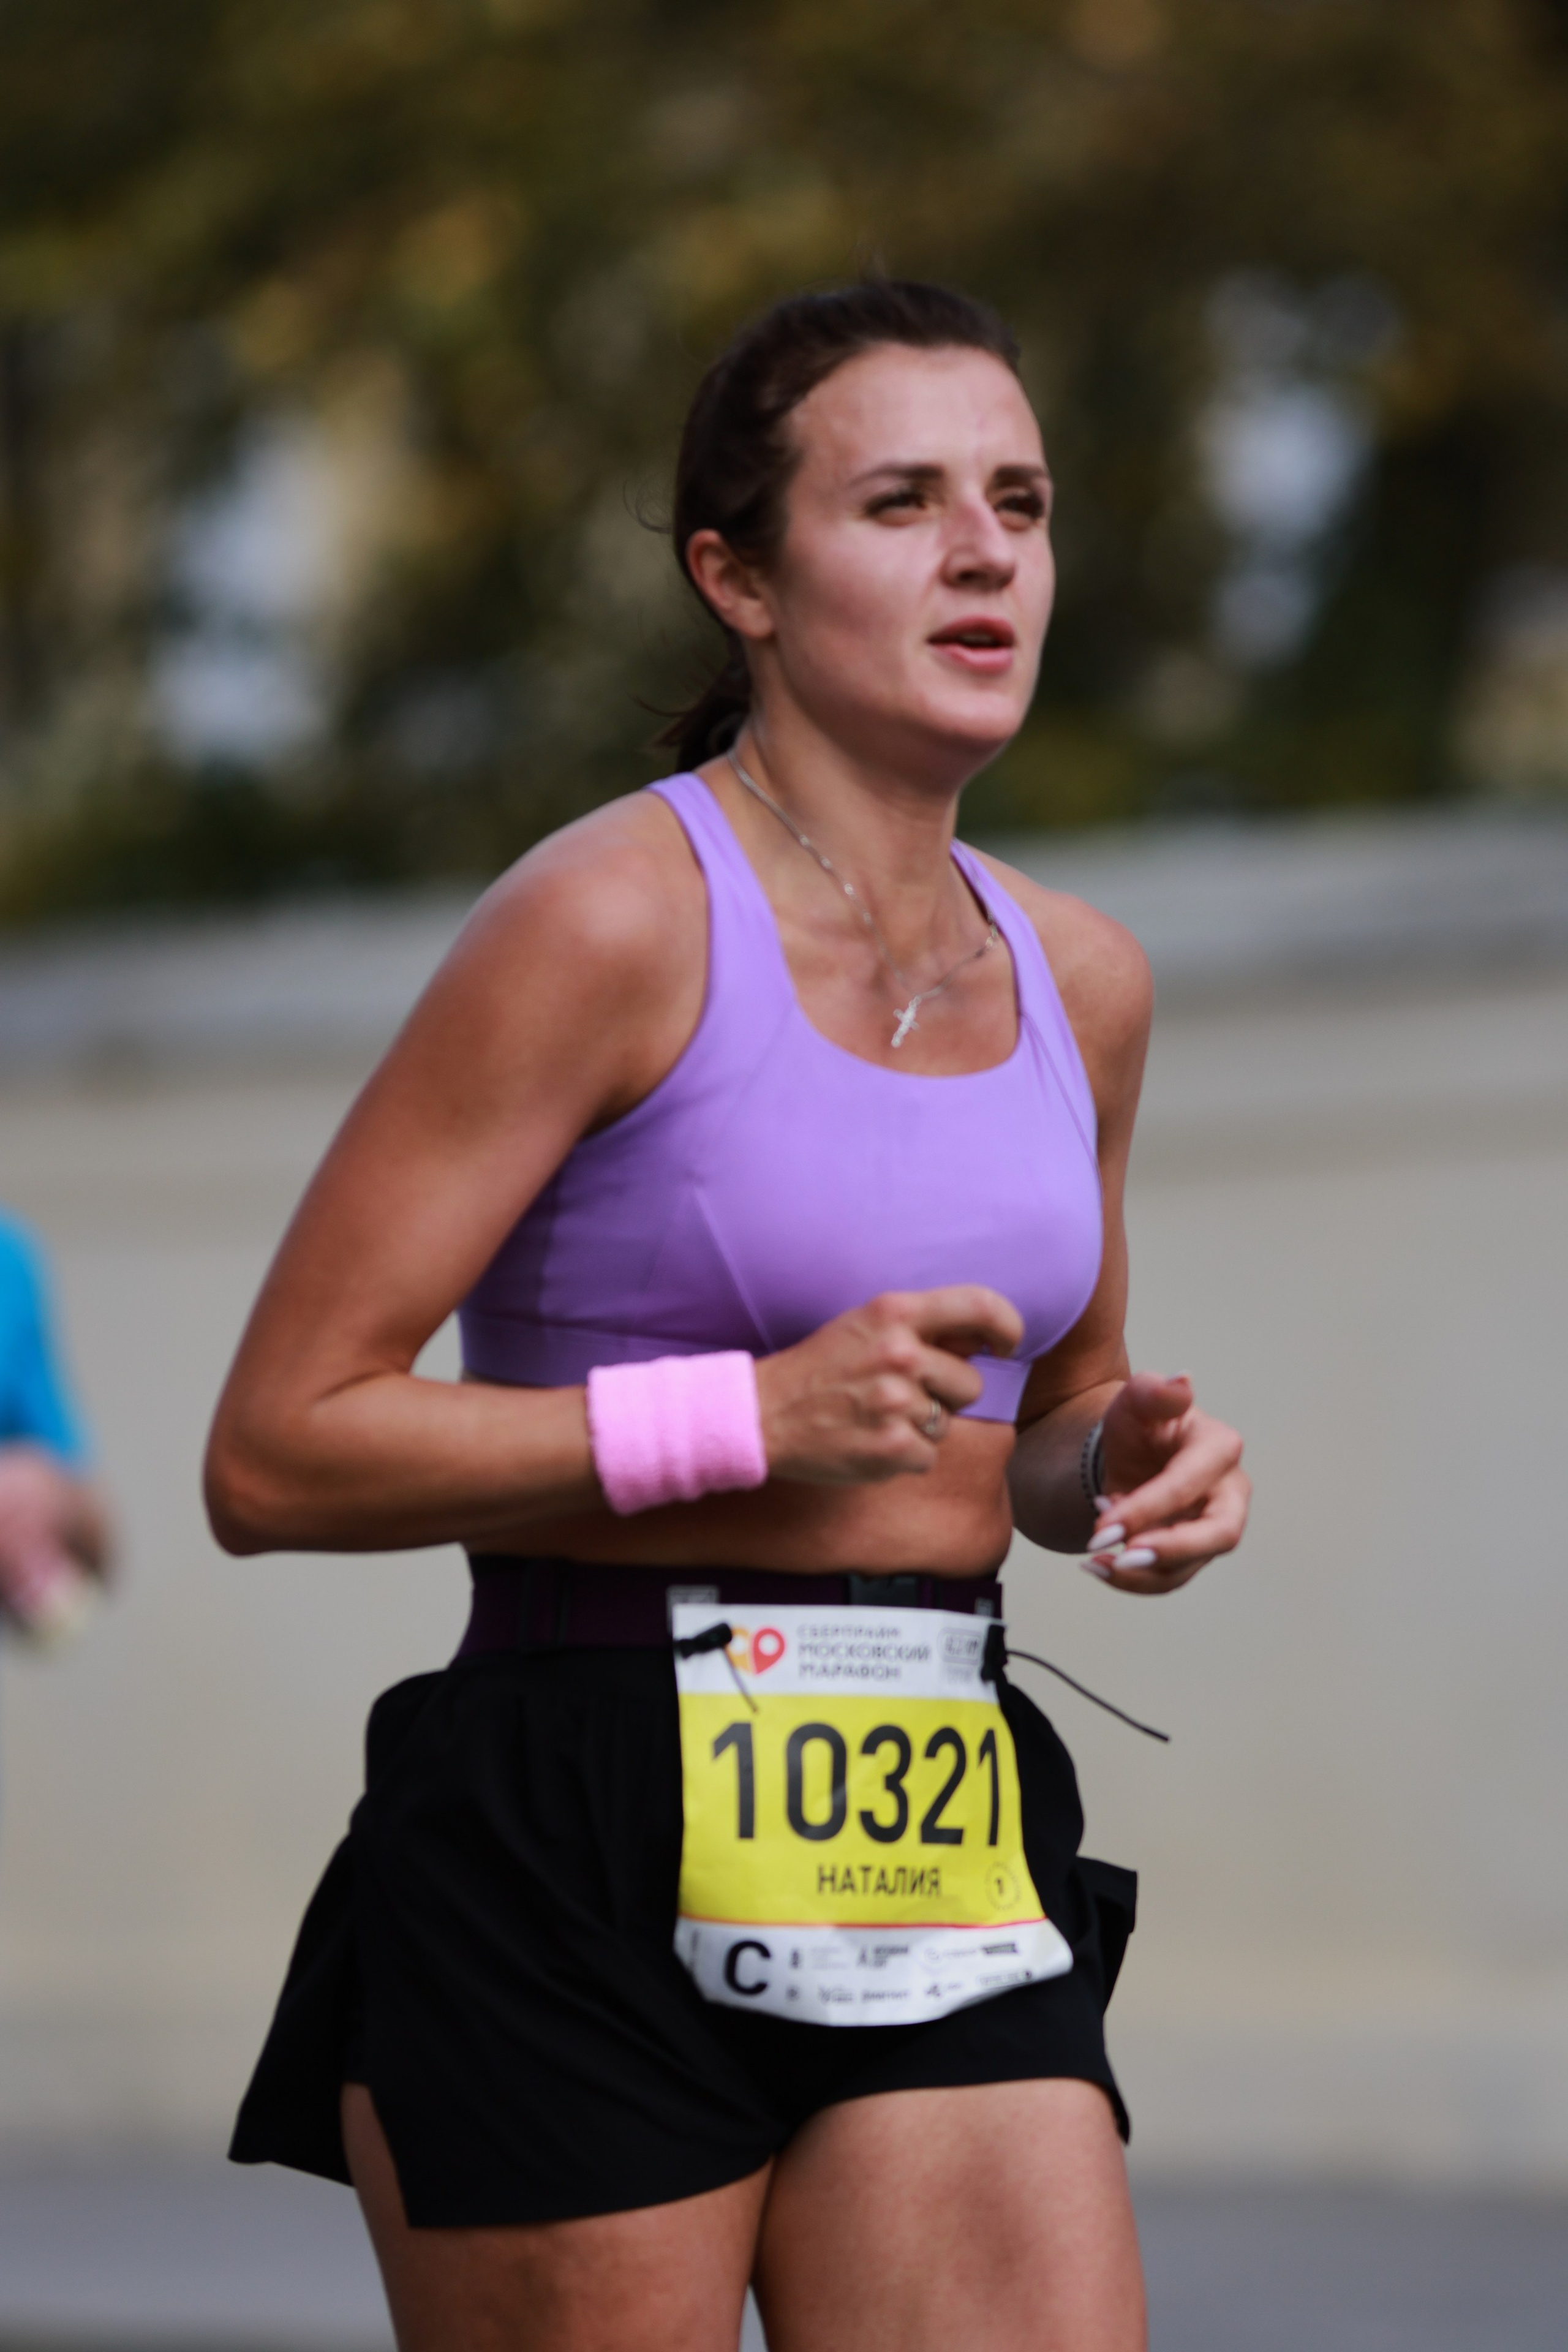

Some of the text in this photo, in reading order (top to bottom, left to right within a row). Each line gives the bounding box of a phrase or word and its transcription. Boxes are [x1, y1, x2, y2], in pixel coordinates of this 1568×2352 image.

[797, 1643, 930, 1660] МОСКОВСКИЙ
[798, 1662, 901, 1680] МАРАФОН
[710, 1722, 1000, 1846] 10321
[817, 1864, 941, 1896] НАТАЛИЯ
